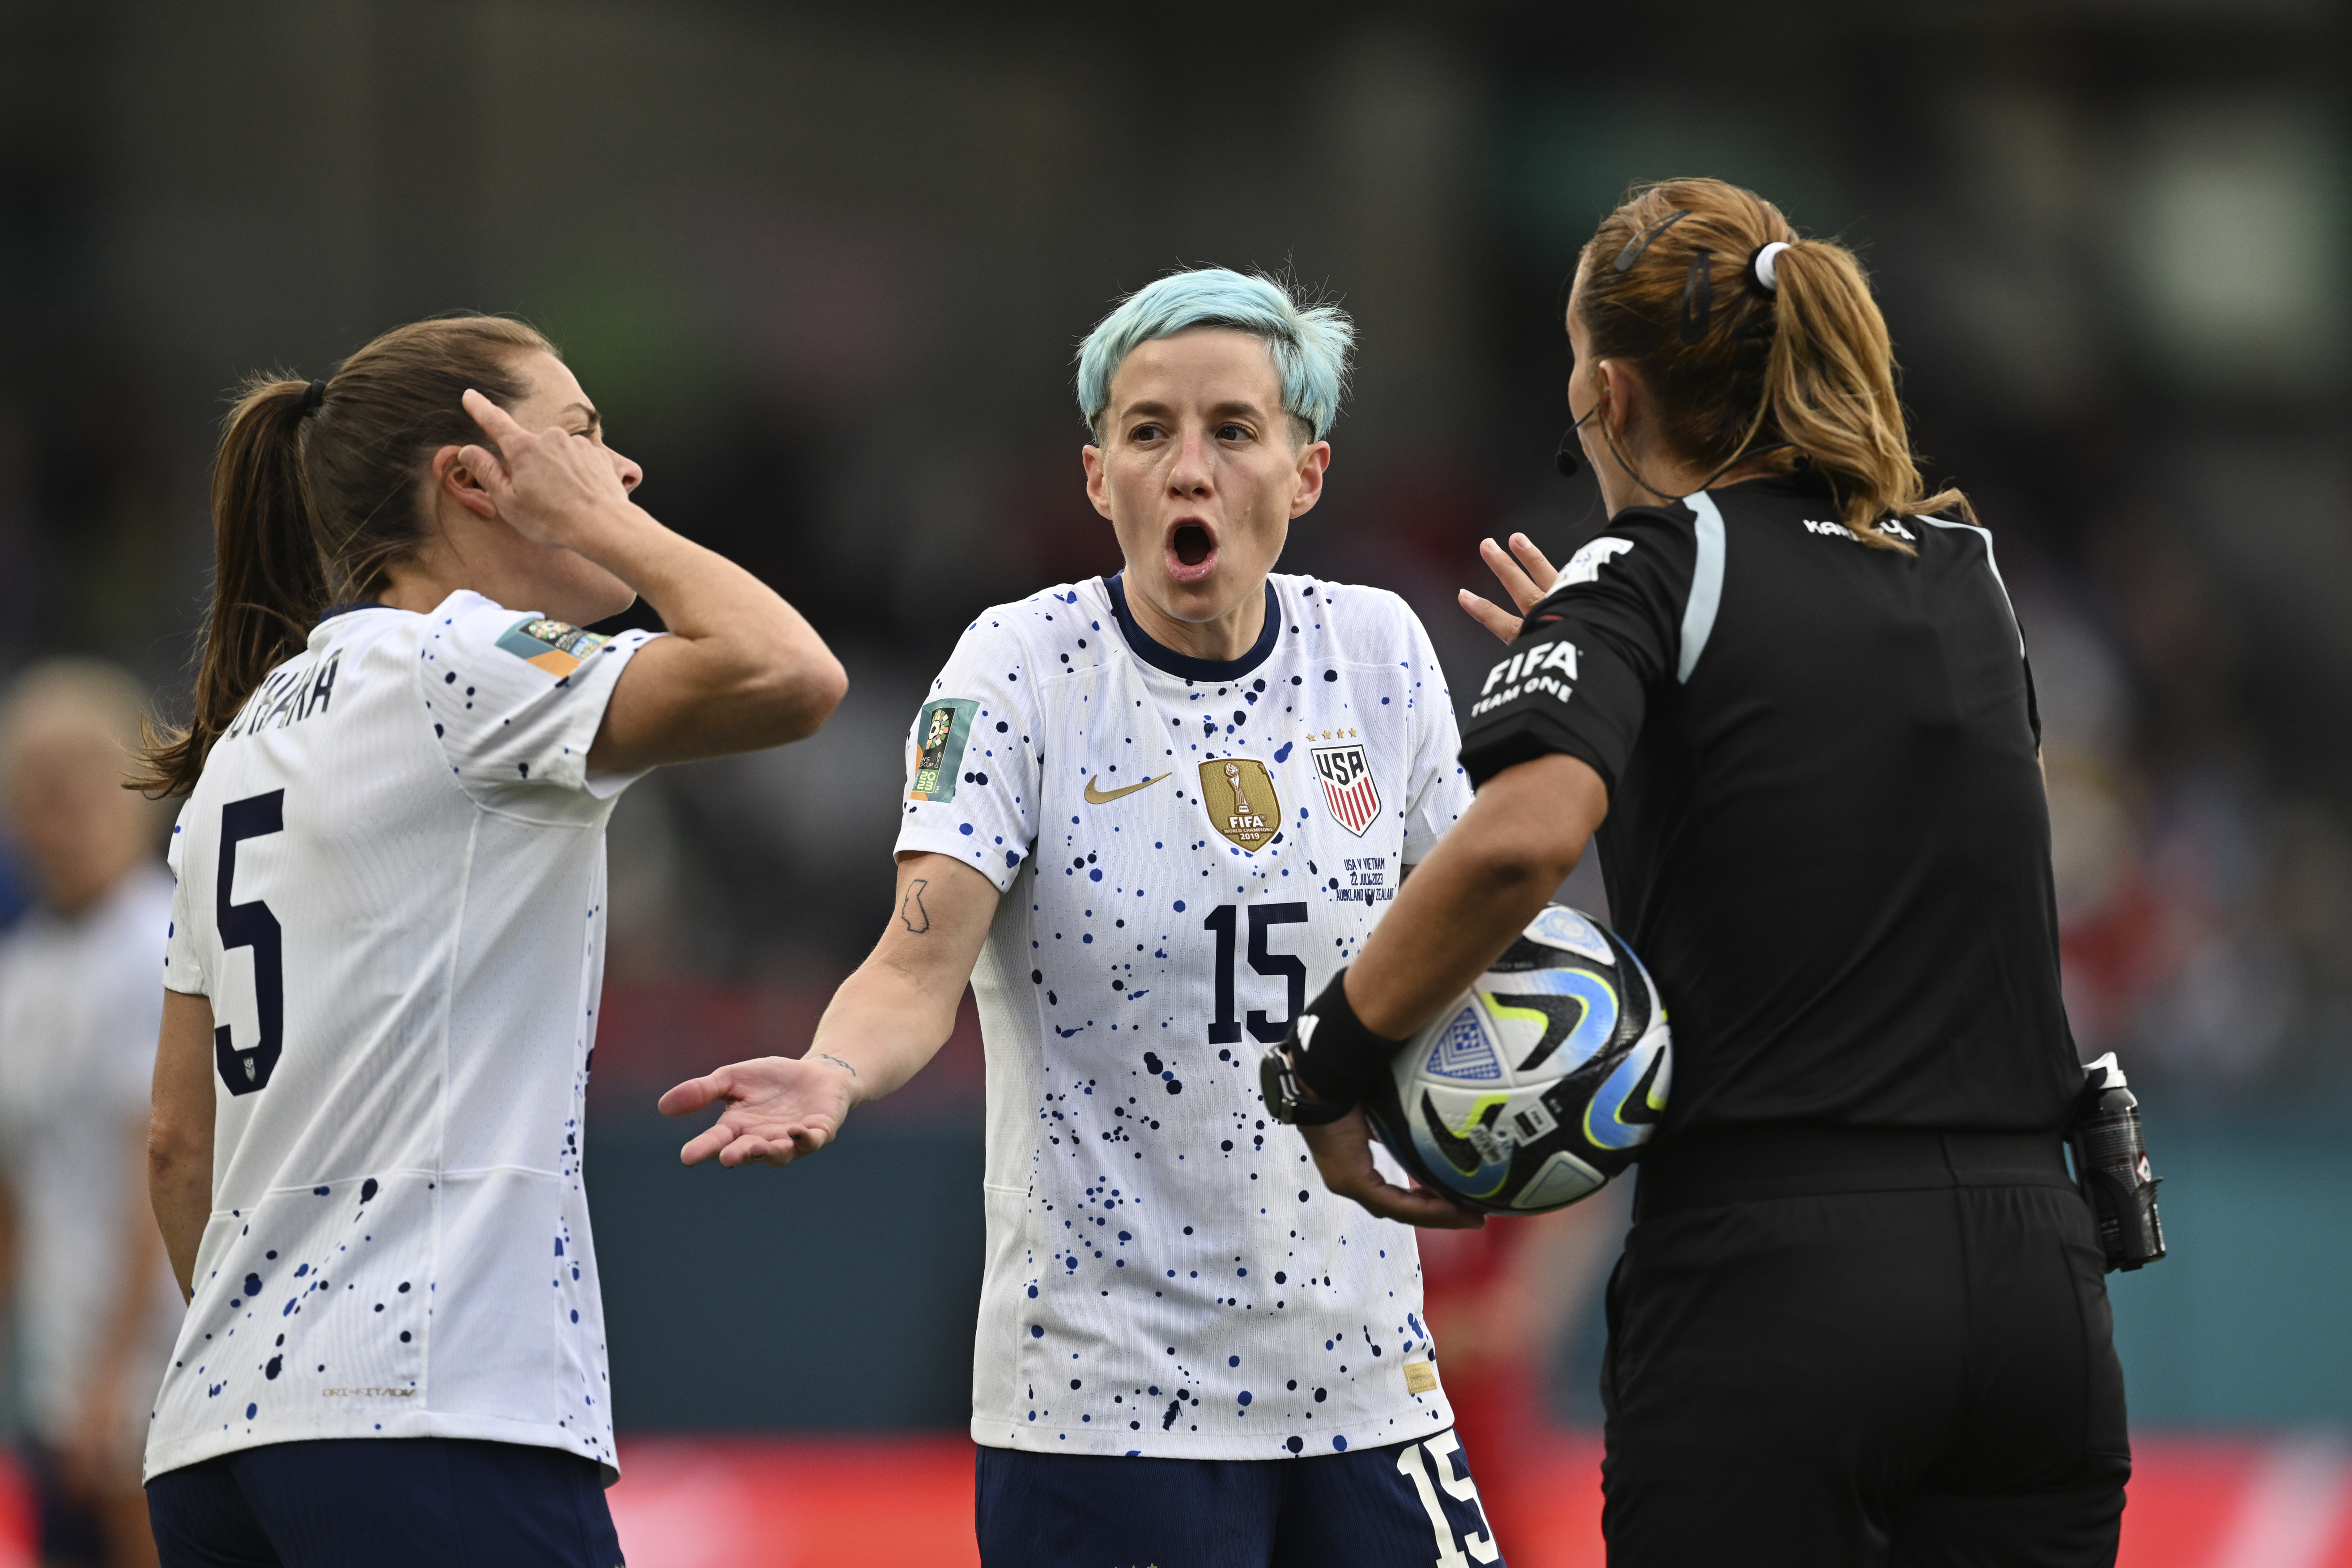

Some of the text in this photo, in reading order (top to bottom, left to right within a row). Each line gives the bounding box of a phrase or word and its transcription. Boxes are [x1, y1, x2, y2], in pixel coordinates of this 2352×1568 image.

[1480, 640, 1578, 696] FIFA
[1471, 676, 1573, 718] TEAM ONE
[919, 771, 936, 781] 20
[1316, 750, 1364, 786] USA
[917, 780, 934, 790] 23
[1229, 816, 1264, 828] FIFA
[1344, 857, 1385, 871] USA V VIETNAM
[1350, 873, 1383, 886] 22 JULY 2023
[1336, 888, 1363, 901] AUCKLAND
[1376, 888, 1394, 901] ZEALAND
[215, 788, 285, 1096] 5
[1204, 901, 1308, 1045] 15
[1396, 1428, 1499, 1568] 15
